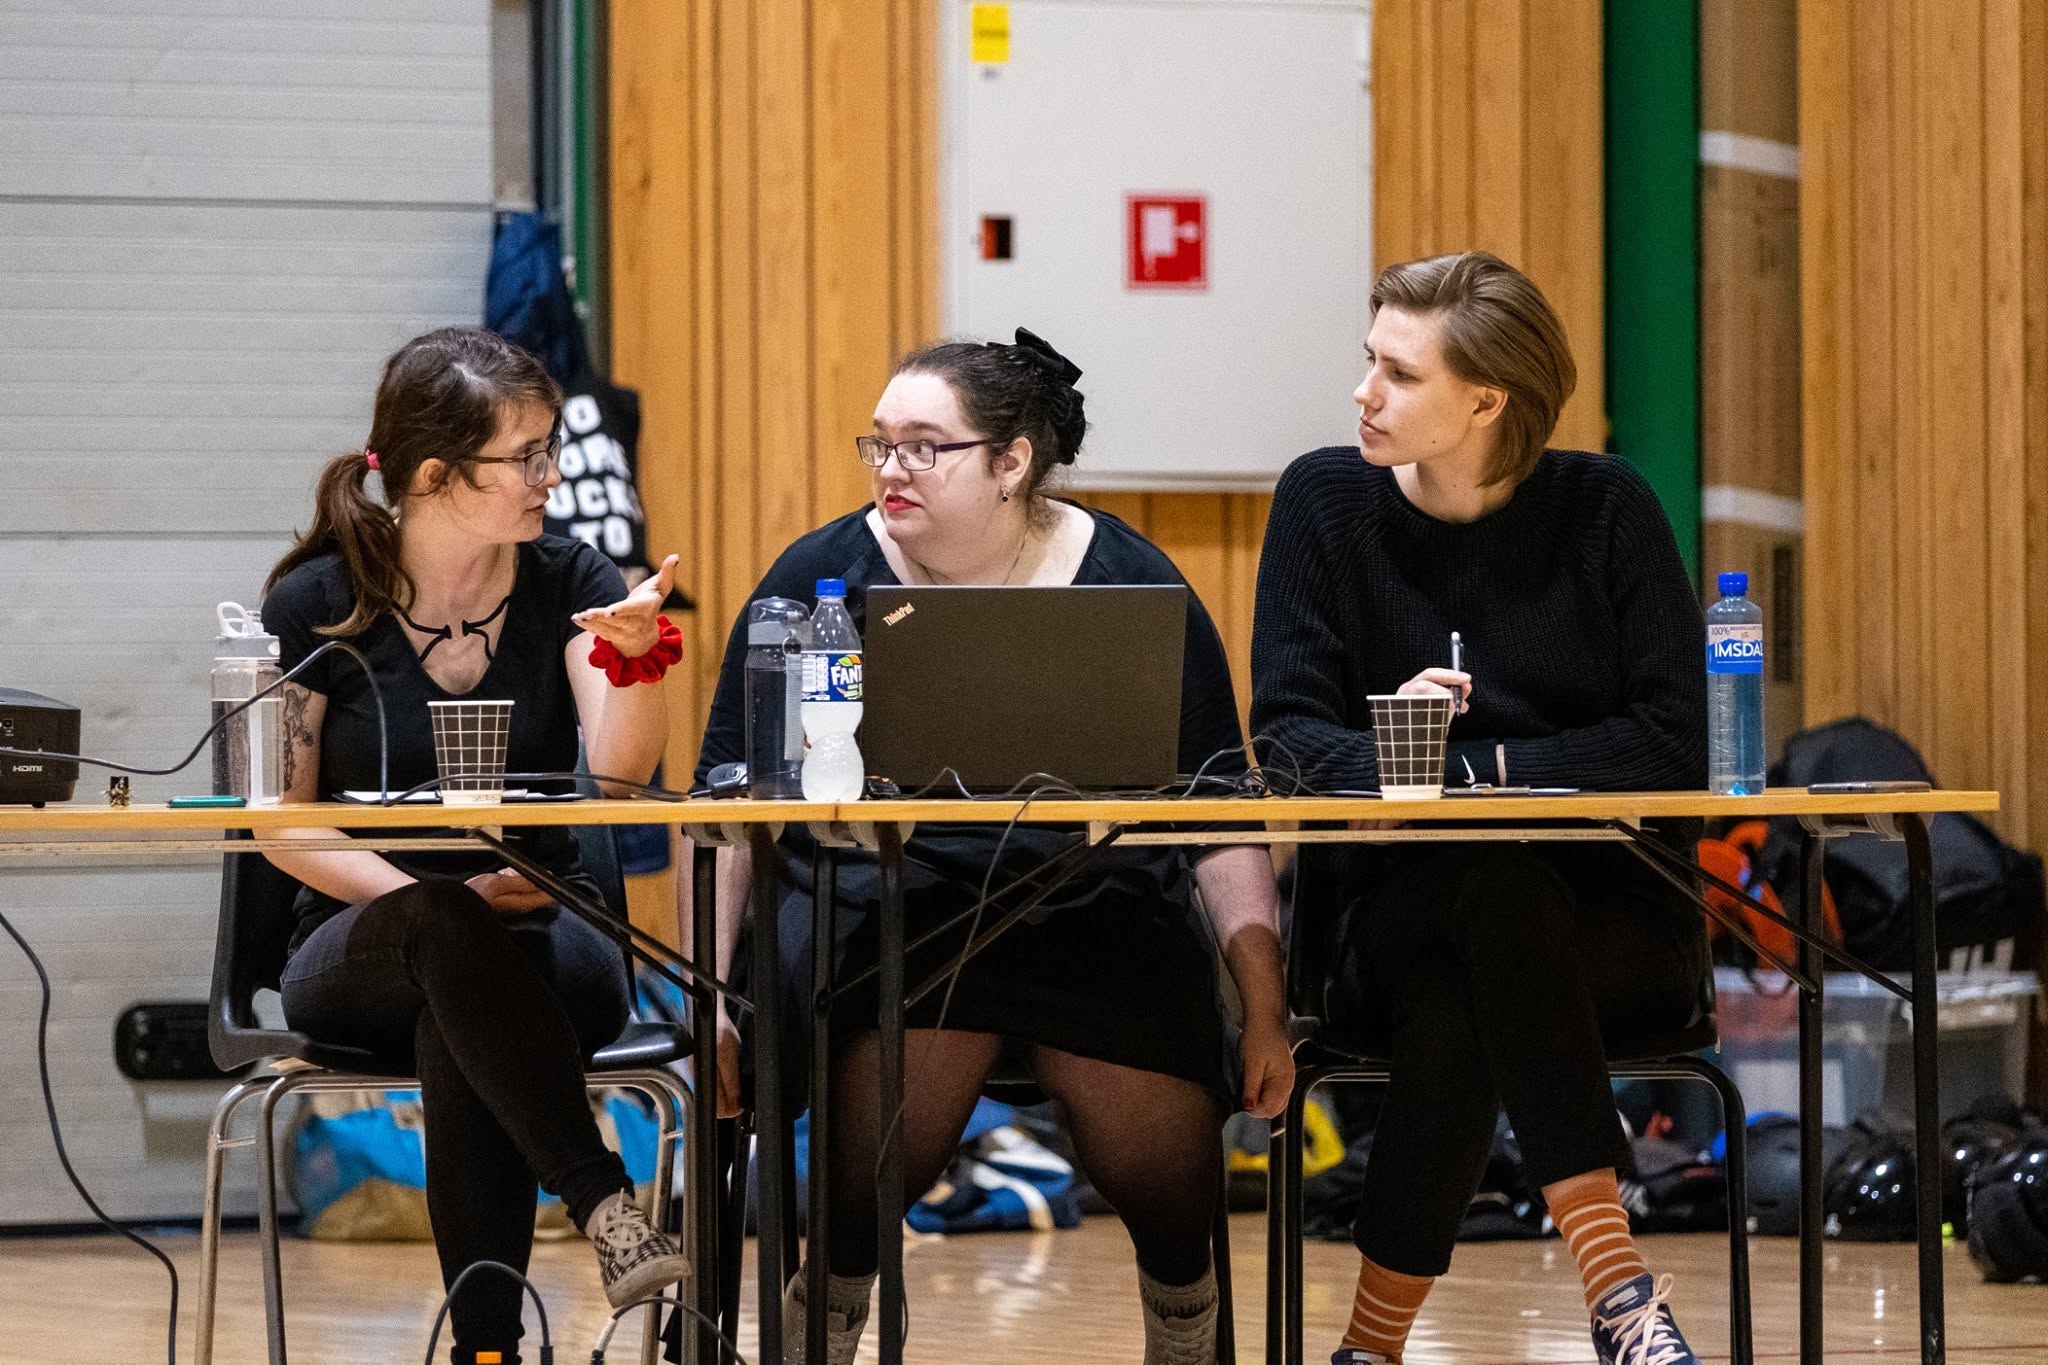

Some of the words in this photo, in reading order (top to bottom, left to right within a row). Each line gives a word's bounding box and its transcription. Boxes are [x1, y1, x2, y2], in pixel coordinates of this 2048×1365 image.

[560, 394, 602, 444] O
[544, 476, 645, 522] UCK
[569, 515, 633, 557] TO
[882, 602, 915, 626] ThinkPad
[830, 664, 862, 686] FANT
